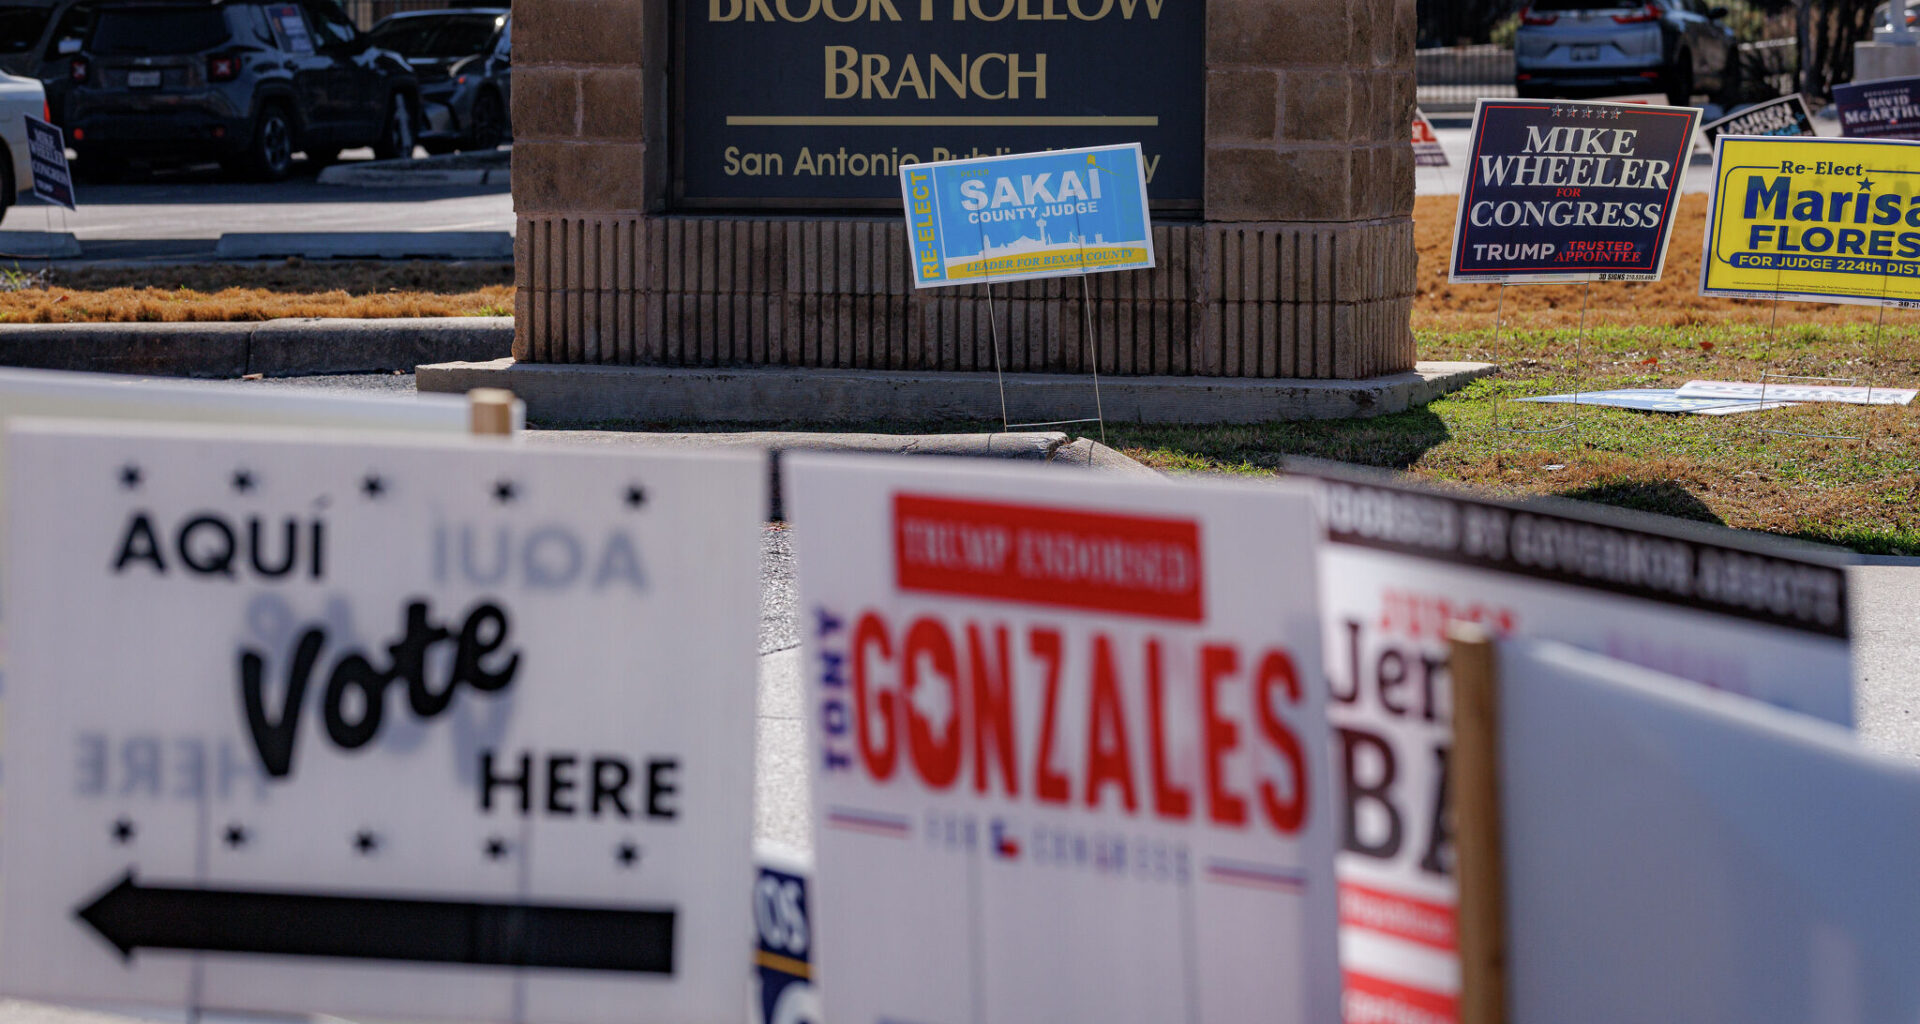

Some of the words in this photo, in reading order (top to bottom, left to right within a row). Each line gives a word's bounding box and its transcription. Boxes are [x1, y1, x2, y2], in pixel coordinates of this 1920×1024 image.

[824, 45, 1047, 99] BRANCH
[1868, 95, 1910, 108] DAVID
[1521, 126, 1638, 156] MIKE
[724, 146, 783, 176] San
[1480, 155, 1670, 190] WHEELER
[1780, 160, 1863, 176] Re-Elect
[960, 168, 1102, 211] SAKAI
[1556, 188, 1581, 198] FOR
[910, 171, 940, 278] RE-ELECT
[968, 206, 1039, 224] COUNTY
[1041, 201, 1098, 218] JUDGE
[1470, 200, 1662, 228] CONGRESS
[1473, 243, 1555, 261] TRUMP
[1568, 241, 1634, 251] TRUSTED
[1554, 251, 1642, 262] APPOINTEE
[1749, 225, 1920, 258] FLORES
[967, 259, 1014, 272] LEADER
[1017, 256, 1040, 267] FOR
[1043, 253, 1083, 265] BEXAR
[1086, 249, 1134, 262] COUNTY
[1738, 255, 1773, 267] FOR
[1776, 257, 1833, 270] JUDGE
[1836, 260, 1882, 273] 224th
[903, 518, 1006, 575] TRUMP
[240, 598, 522, 778] Vote
[814, 607, 851, 771] TONY
[852, 611, 1308, 836] GONZALES
[480, 751, 682, 822] HERE
